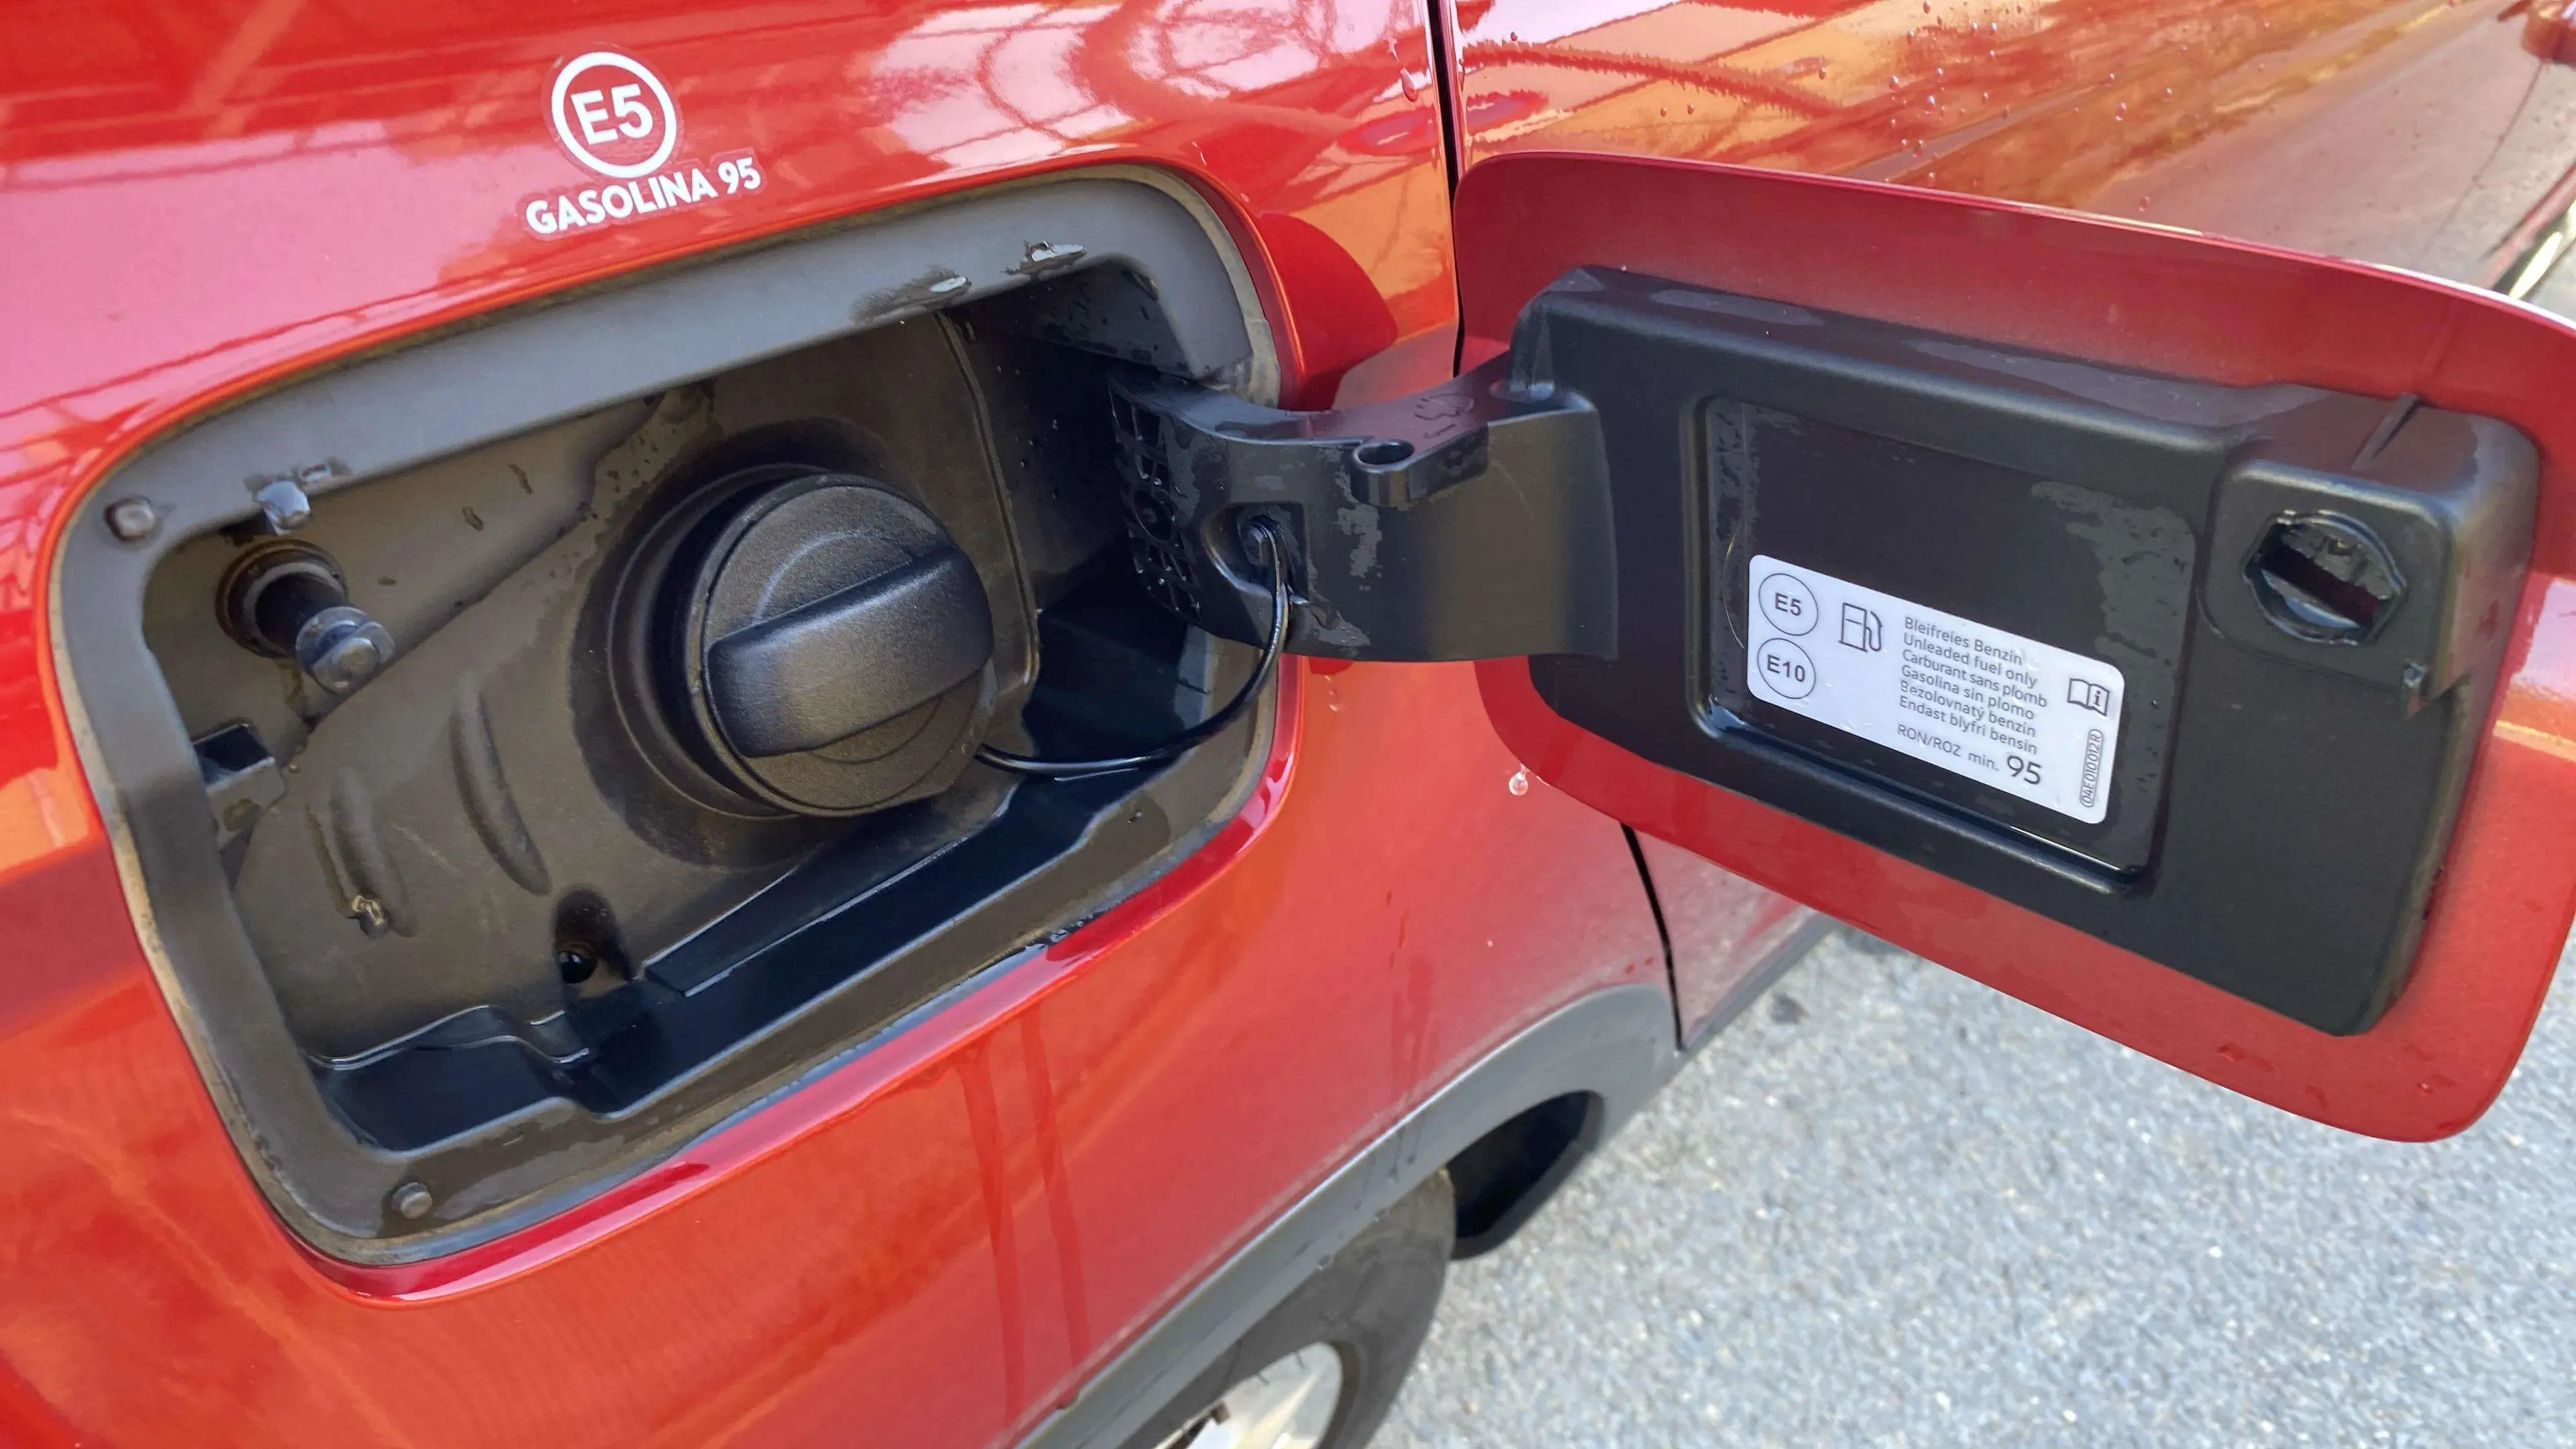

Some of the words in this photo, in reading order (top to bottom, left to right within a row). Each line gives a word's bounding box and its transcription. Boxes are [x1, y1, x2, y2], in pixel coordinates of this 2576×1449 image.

[571, 83, 653, 145] E5
[526, 168, 718, 234] GASOLINA
[718, 157, 761, 195] 95
[1775, 592, 1801, 616] E5
[1766, 653, 1806, 683] E10
[1903, 632, 1970, 665] Unleaded
[1974, 655, 2002, 676] fuel
[2005, 669, 2037, 690] only
[1904, 616, 1970, 648] Bleifreies
[1974, 639, 2023, 666] Benzin
[1901, 665, 1960, 694] Gasolina
[1963, 687, 1984, 703] sin
[1988, 696, 2035, 720] plomo
[1902, 649, 1968, 681] Carburant
[1969, 674, 2000, 692] sans
[2002, 684, 2047, 707] plomb
[1900, 680, 1984, 721] Bezolovnatý
[1988, 710, 2036, 738] benzin
[1900, 695, 1946, 722] Endast
[1949, 712, 1986, 737] blyfri
[1990, 727, 2037, 755] bensin
[1968, 752, 2000, 771] min.
[2006, 755, 2042, 785] 95
